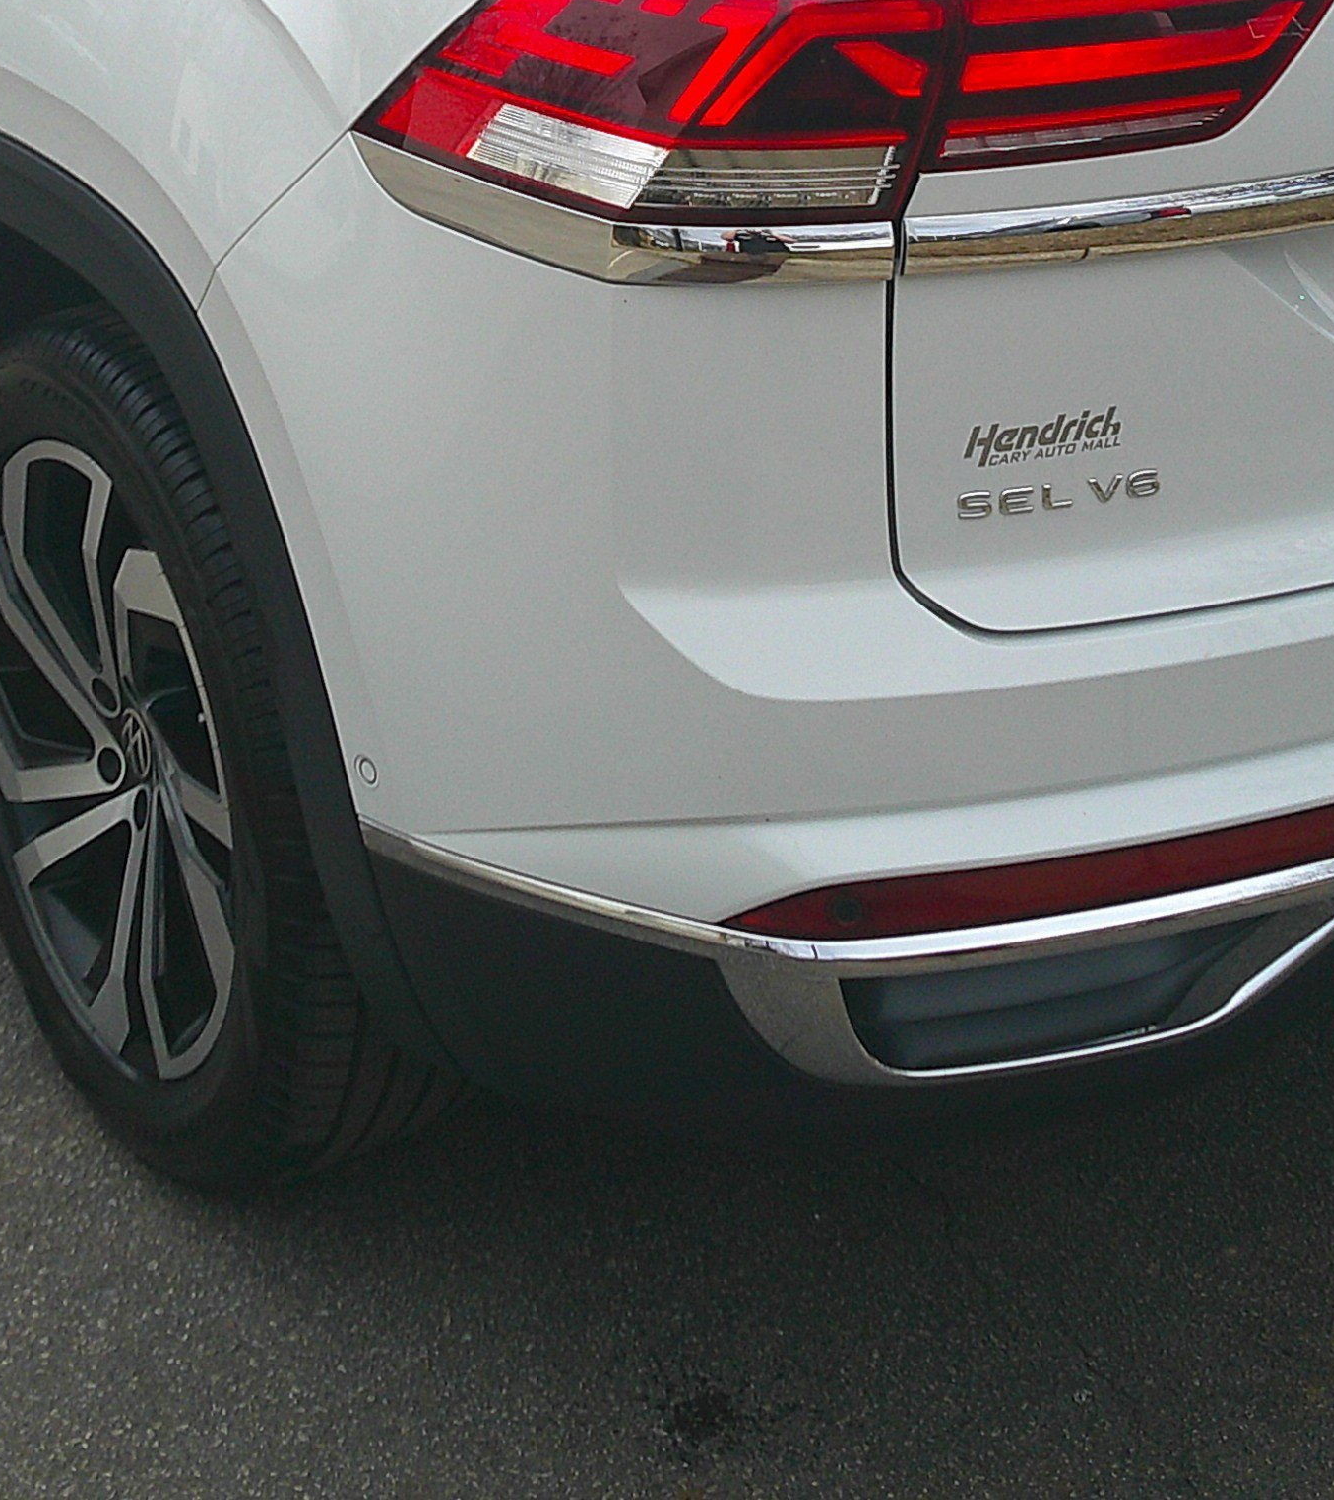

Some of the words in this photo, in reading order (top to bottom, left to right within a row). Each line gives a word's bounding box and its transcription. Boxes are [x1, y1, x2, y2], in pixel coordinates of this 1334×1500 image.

[964, 405, 1121, 468] Hendrick
[988, 450, 1034, 467] CARY
[1034, 441, 1077, 461] AUTO
[1081, 435, 1121, 453] MALL
[956, 482, 1074, 520] SEL
[1087, 467, 1161, 504] V6
